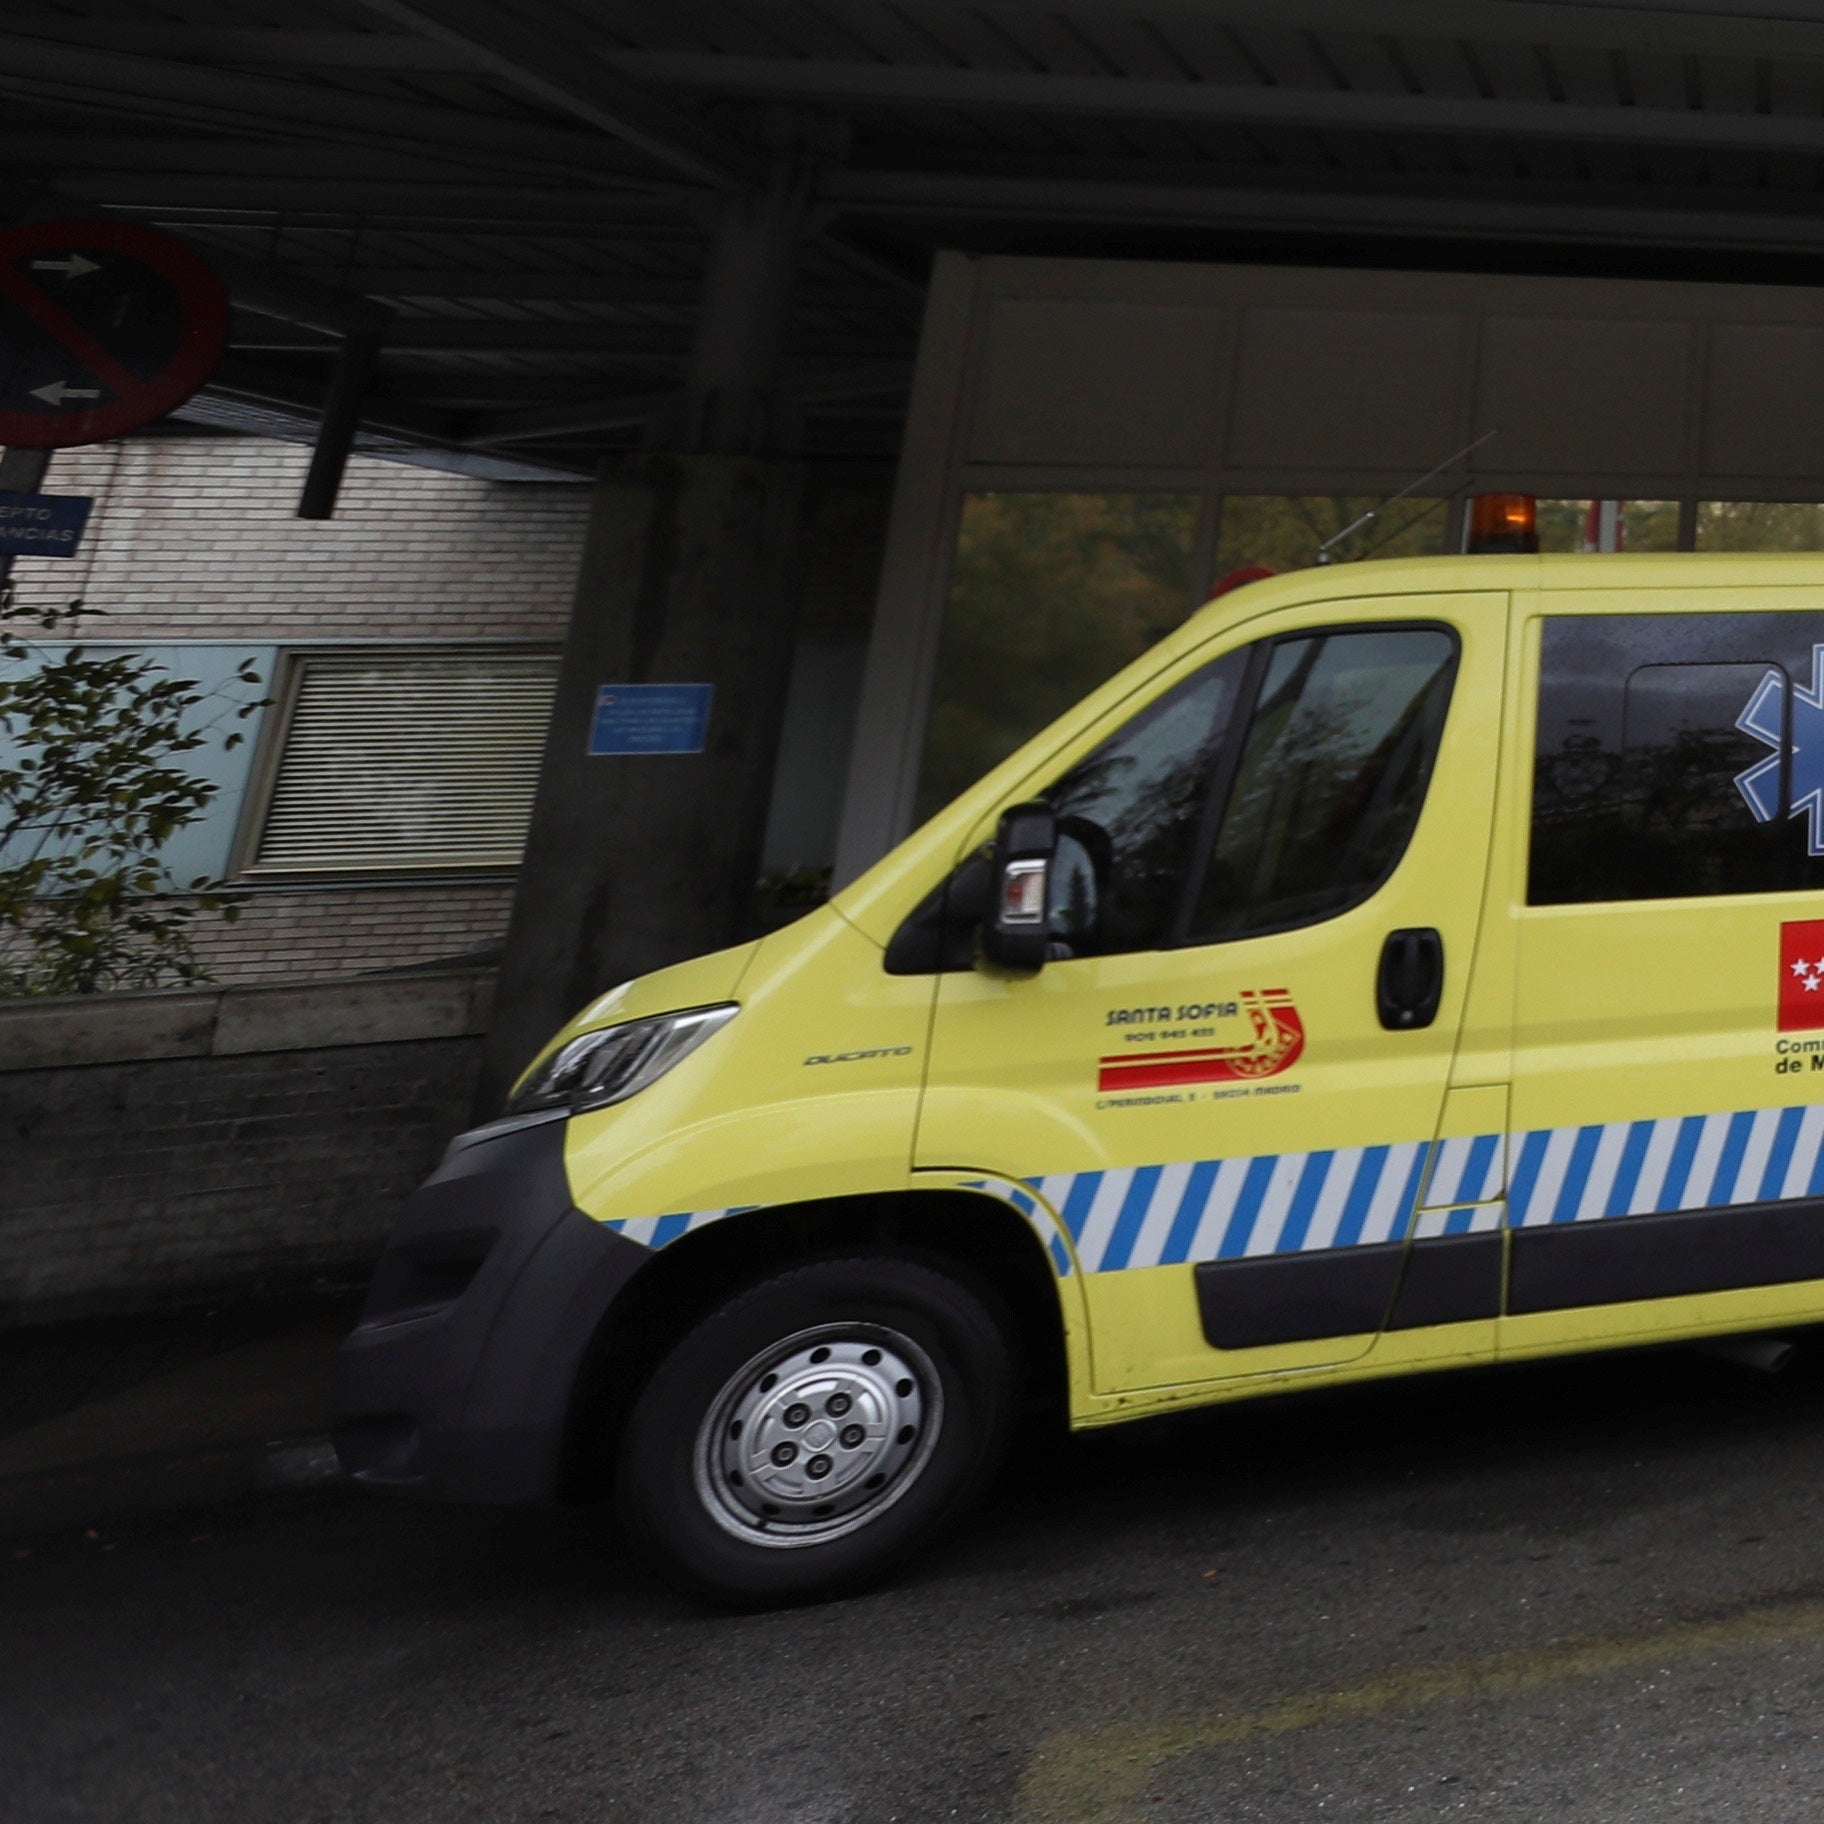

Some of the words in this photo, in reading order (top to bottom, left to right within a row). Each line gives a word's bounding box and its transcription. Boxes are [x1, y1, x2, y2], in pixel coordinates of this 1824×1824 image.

[1105, 1007, 1170, 1027] SANTA
[1175, 1002, 1238, 1022] SOFIA
[802, 1046, 913, 1066] DUCATO
[1775, 1057, 1802, 1075] de
